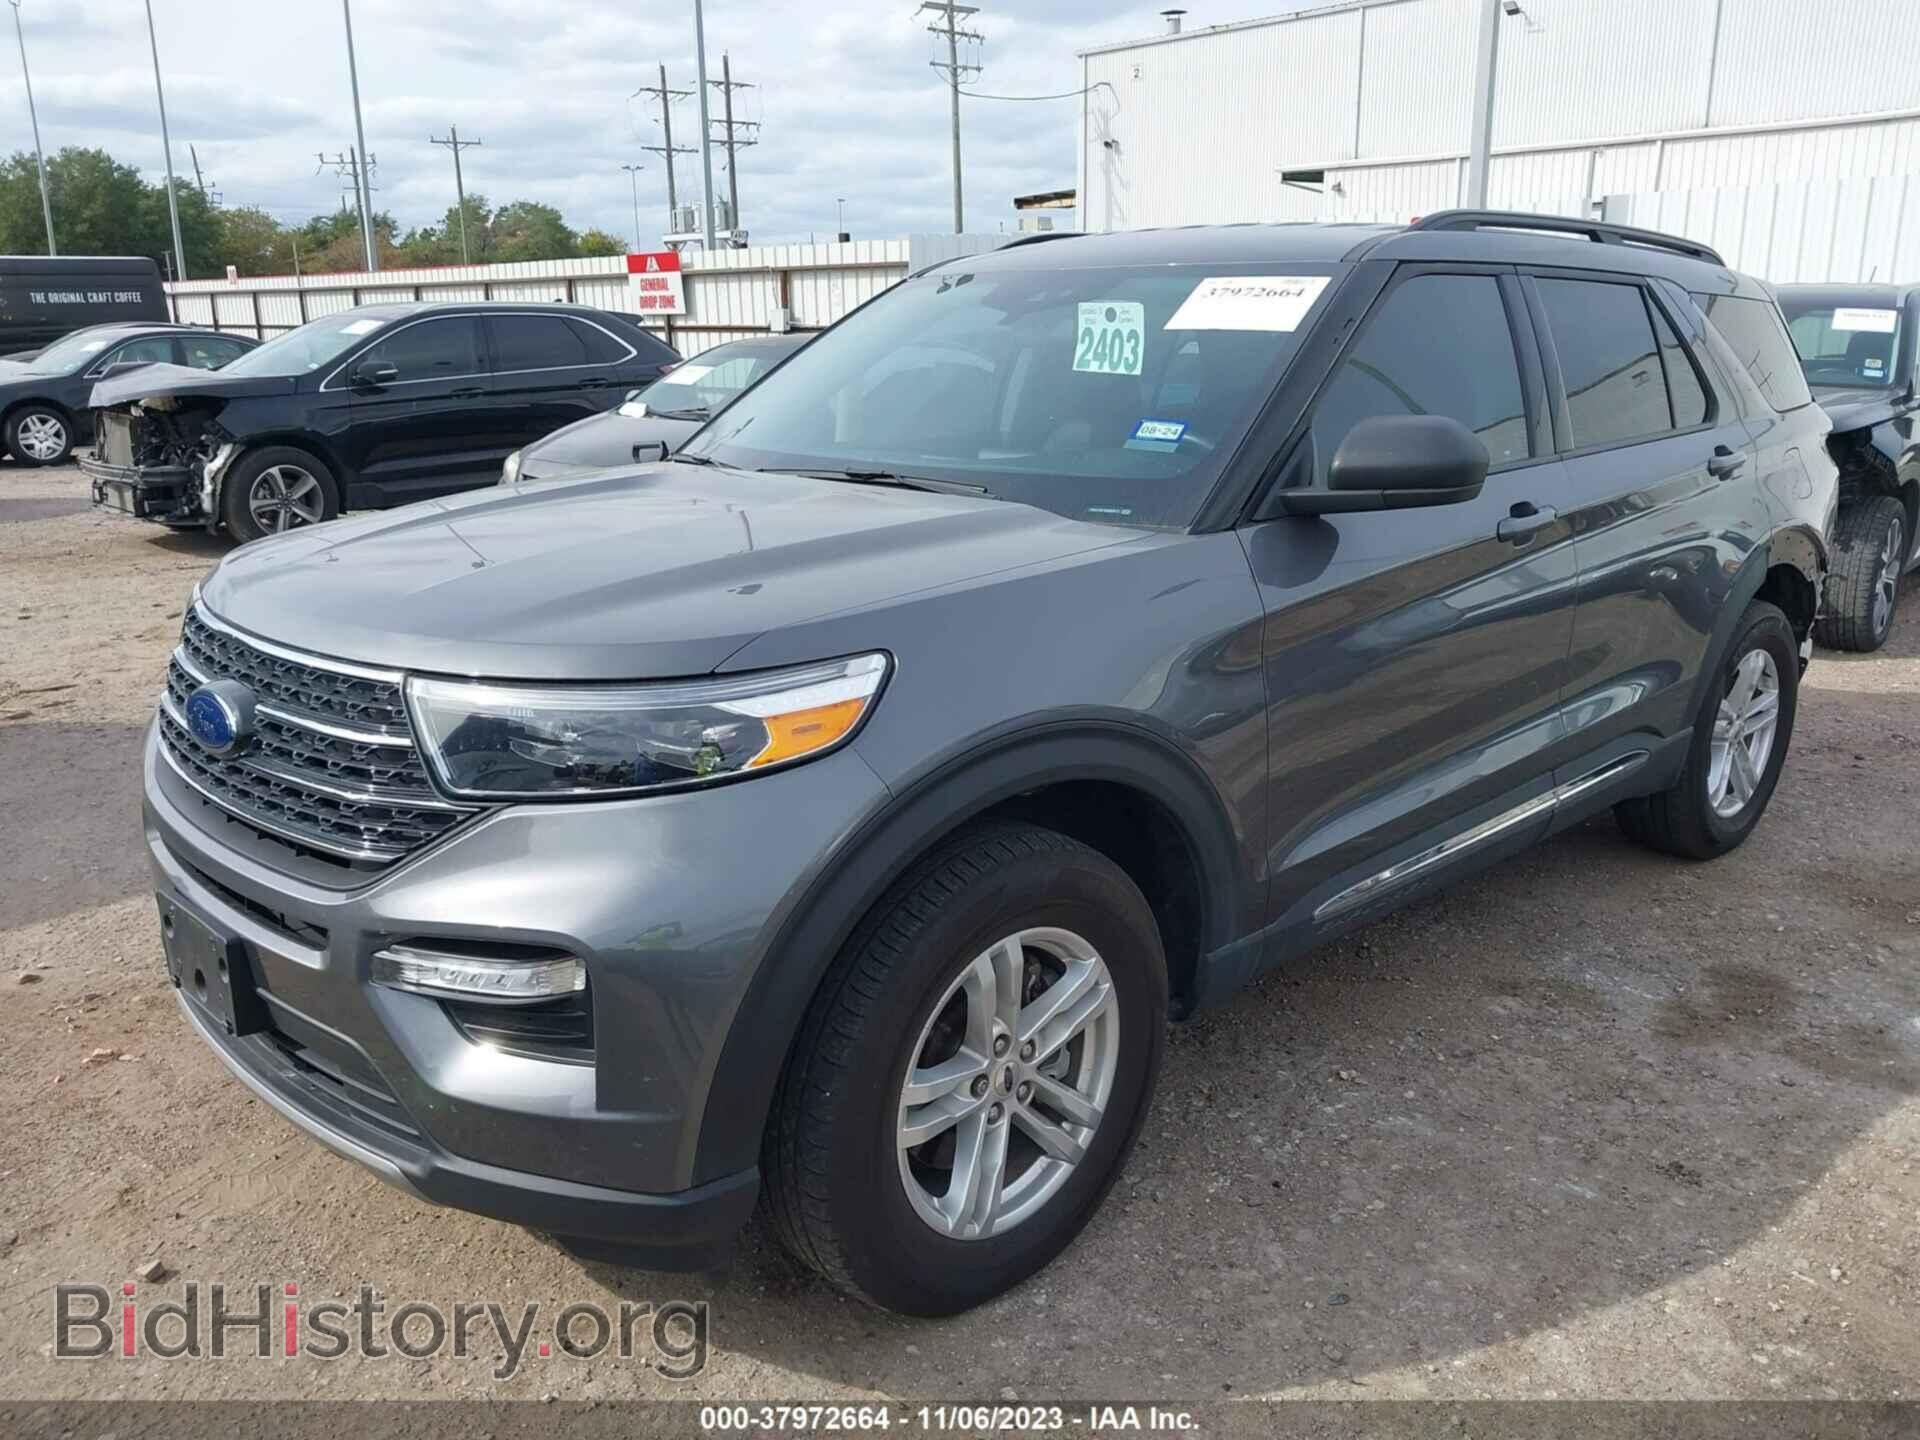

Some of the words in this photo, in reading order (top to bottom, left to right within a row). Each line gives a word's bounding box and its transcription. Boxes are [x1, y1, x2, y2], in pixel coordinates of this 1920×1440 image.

[30, 292, 46, 304] THE
[48, 292, 86, 304] ORIGINAL
[87, 292, 113, 303] CRAFT
[114, 291, 142, 303] COFFEE
[1201, 286, 1305, 300] 37972664
[1075, 326, 1140, 374] 2403
